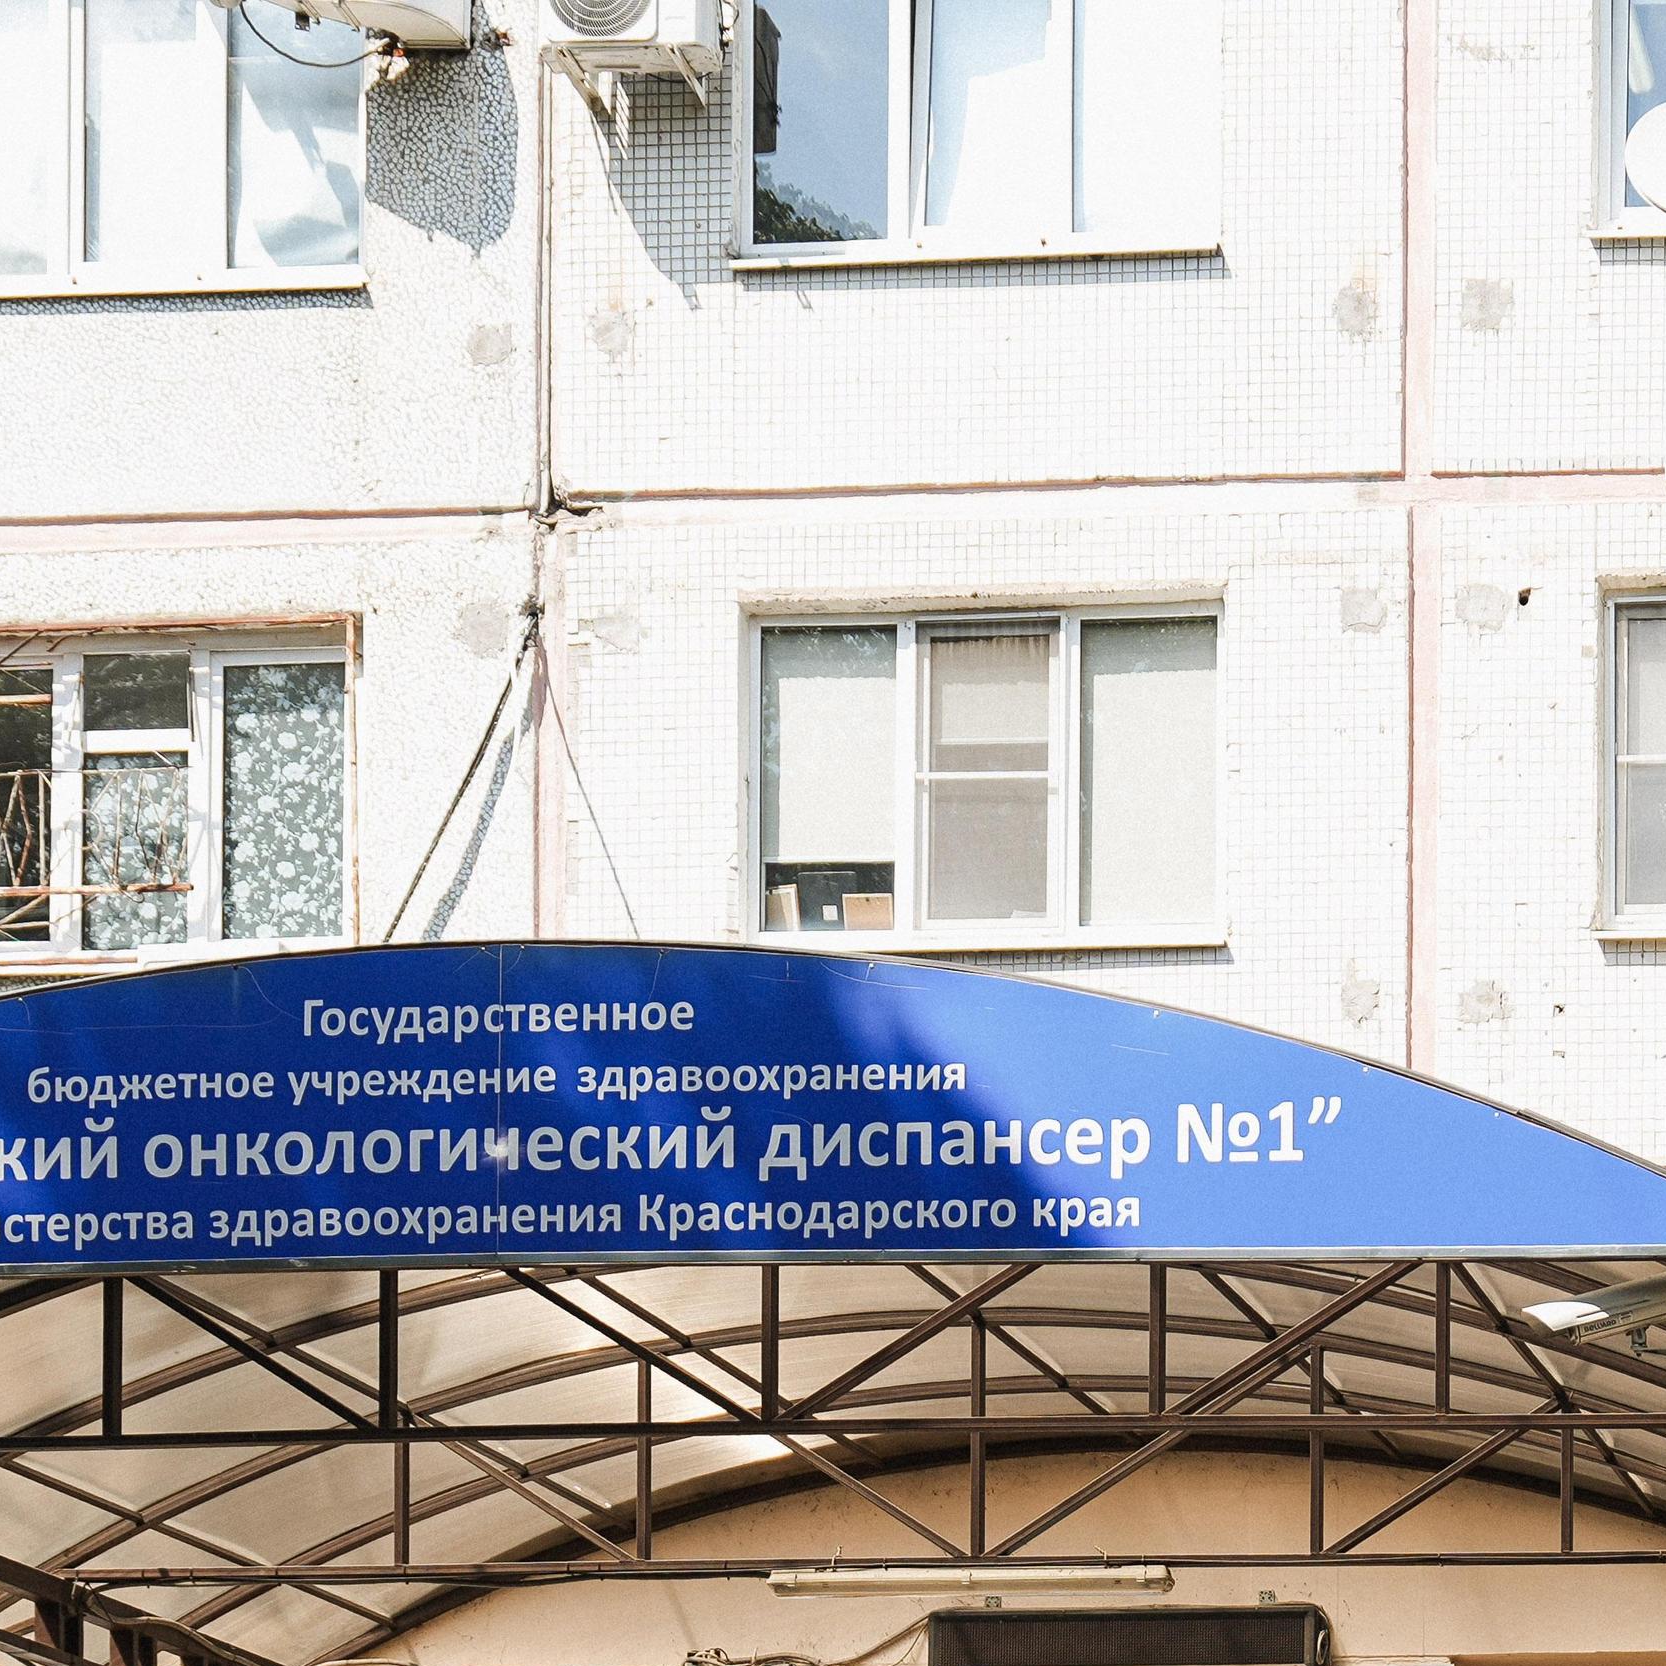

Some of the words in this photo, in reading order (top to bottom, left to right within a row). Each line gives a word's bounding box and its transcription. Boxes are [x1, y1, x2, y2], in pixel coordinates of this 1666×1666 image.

[304, 1000, 694, 1044] Государственное
[28, 1067, 274, 1108] бюджетное
[288, 1066, 556, 1105] учреждение
[578, 1063, 967, 1101] здравоохранения
[145, 1106, 734, 1177] онкологический
[759, 1117, 1150, 1181] диспансер
[210, 1204, 620, 1246] здравоохранения
[640, 1195, 1016, 1240] Краснодарского
[1034, 1197, 1141, 1236] края
